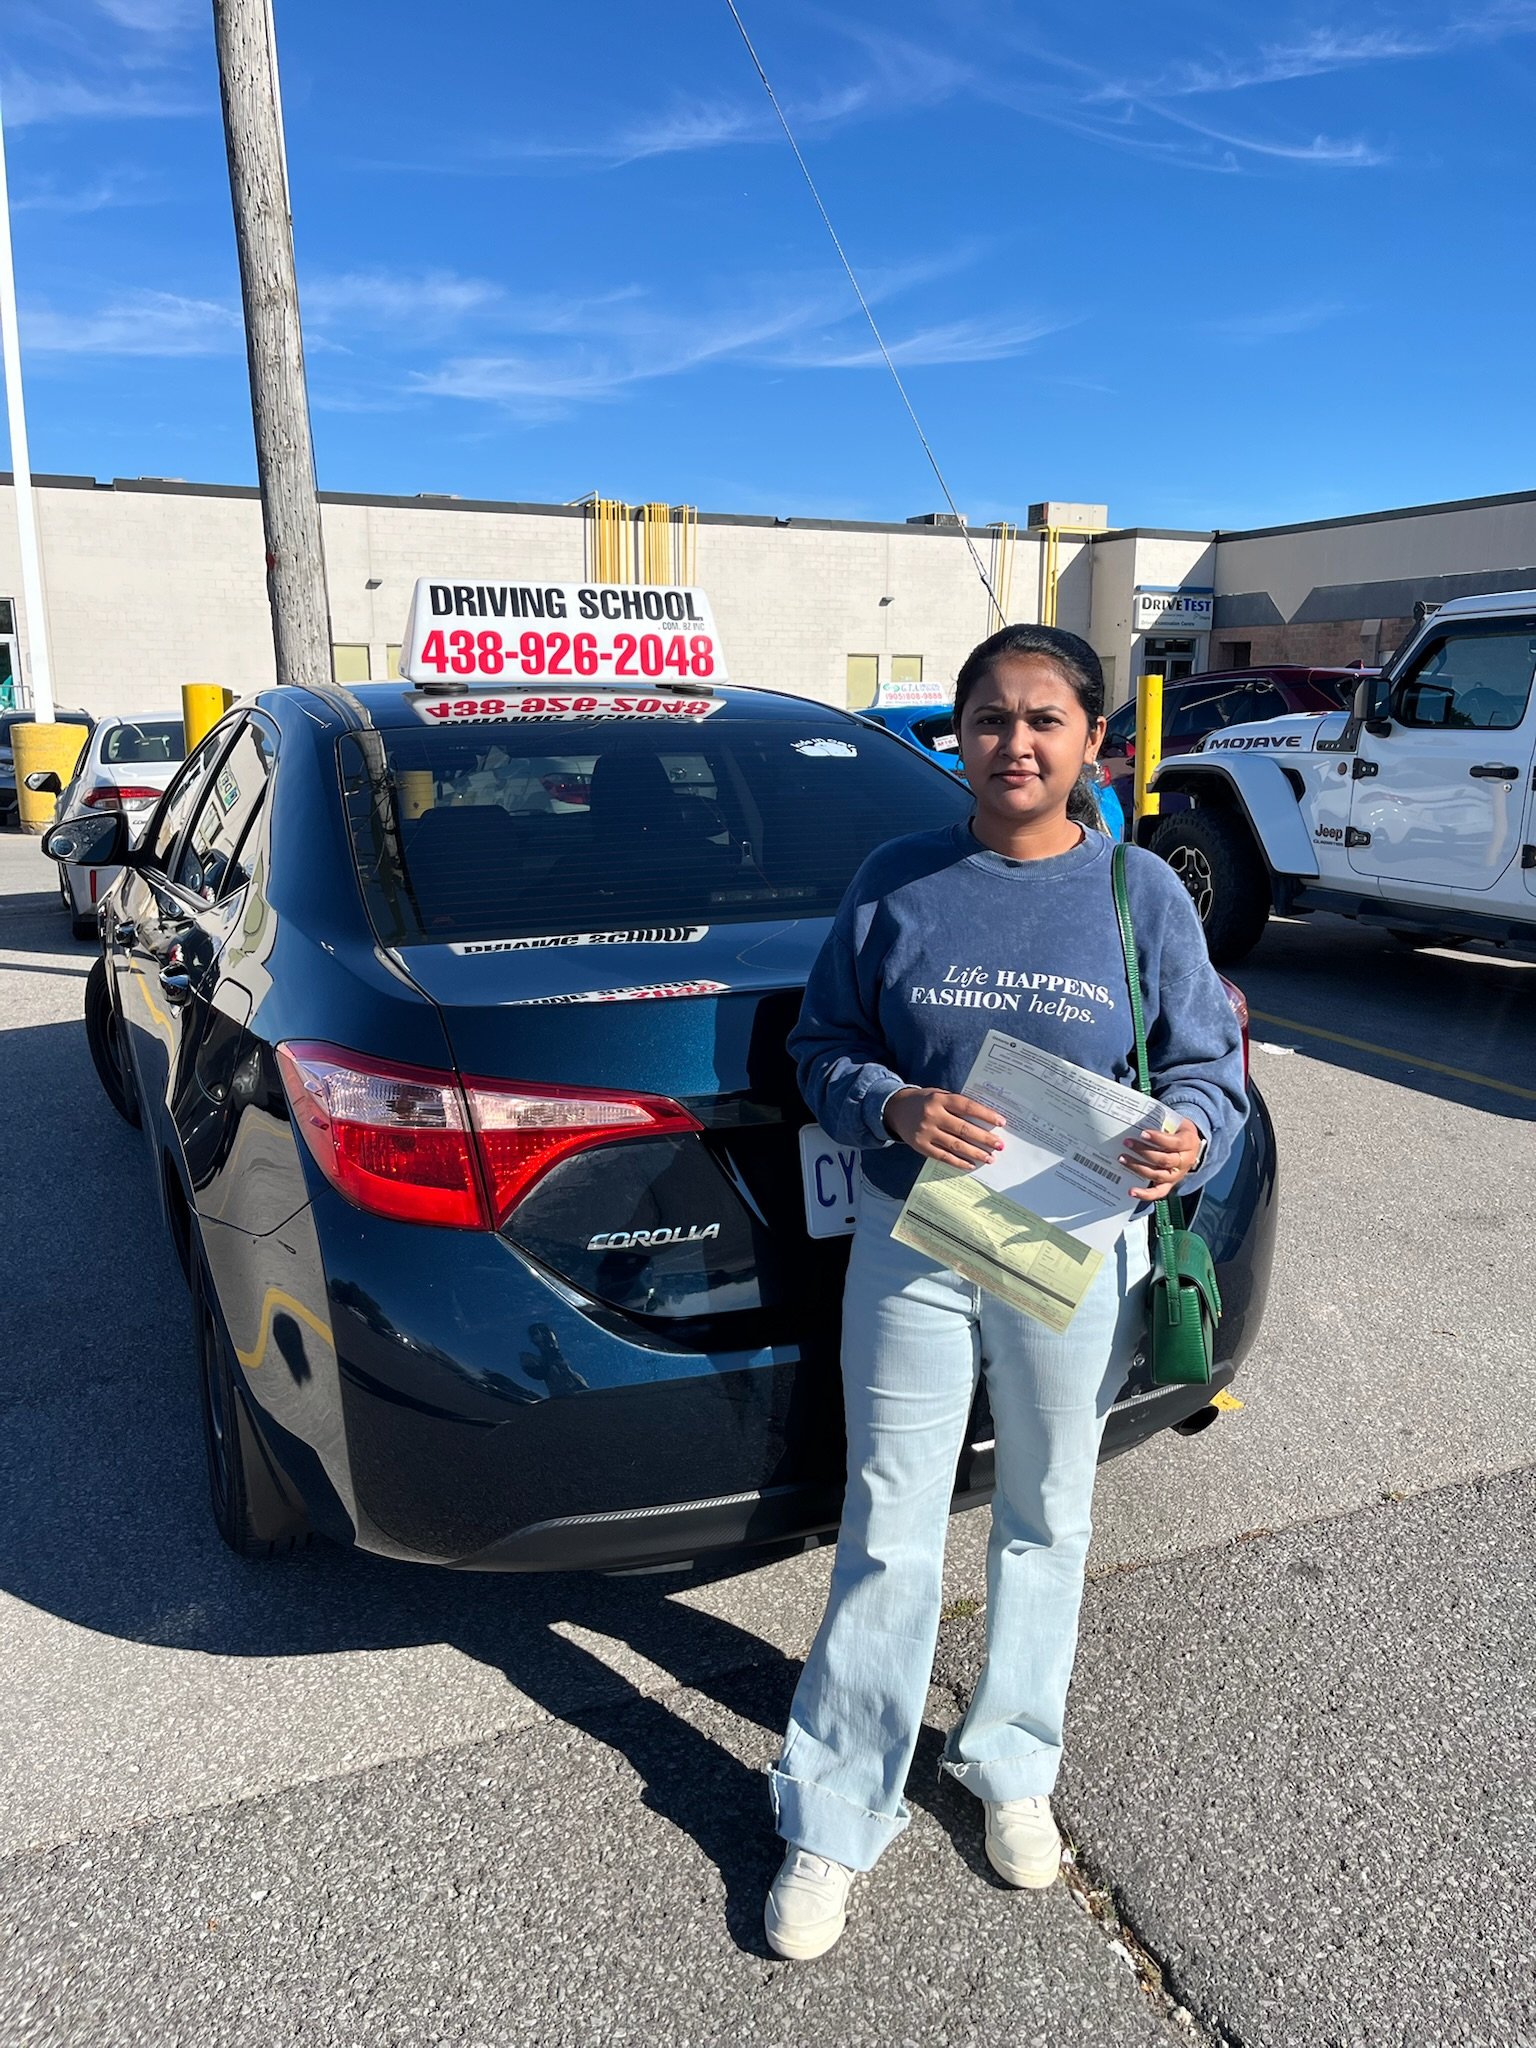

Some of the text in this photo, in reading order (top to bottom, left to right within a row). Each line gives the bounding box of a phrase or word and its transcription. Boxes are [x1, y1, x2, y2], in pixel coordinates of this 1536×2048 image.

[429, 585, 703, 621] DRIVING SCHOOL
[421, 630, 714, 676] 438-926-2048
[1209, 736, 1302, 750] MOJAVE
[1315, 824, 1343, 841] Jeep
[909, 987, 1096, 1024] FASHION helps.
[943, 965, 1115, 1011] Life HAPPENS,
[815, 1150, 855, 1207] CY
[587, 1223, 721, 1251] COROLLA
